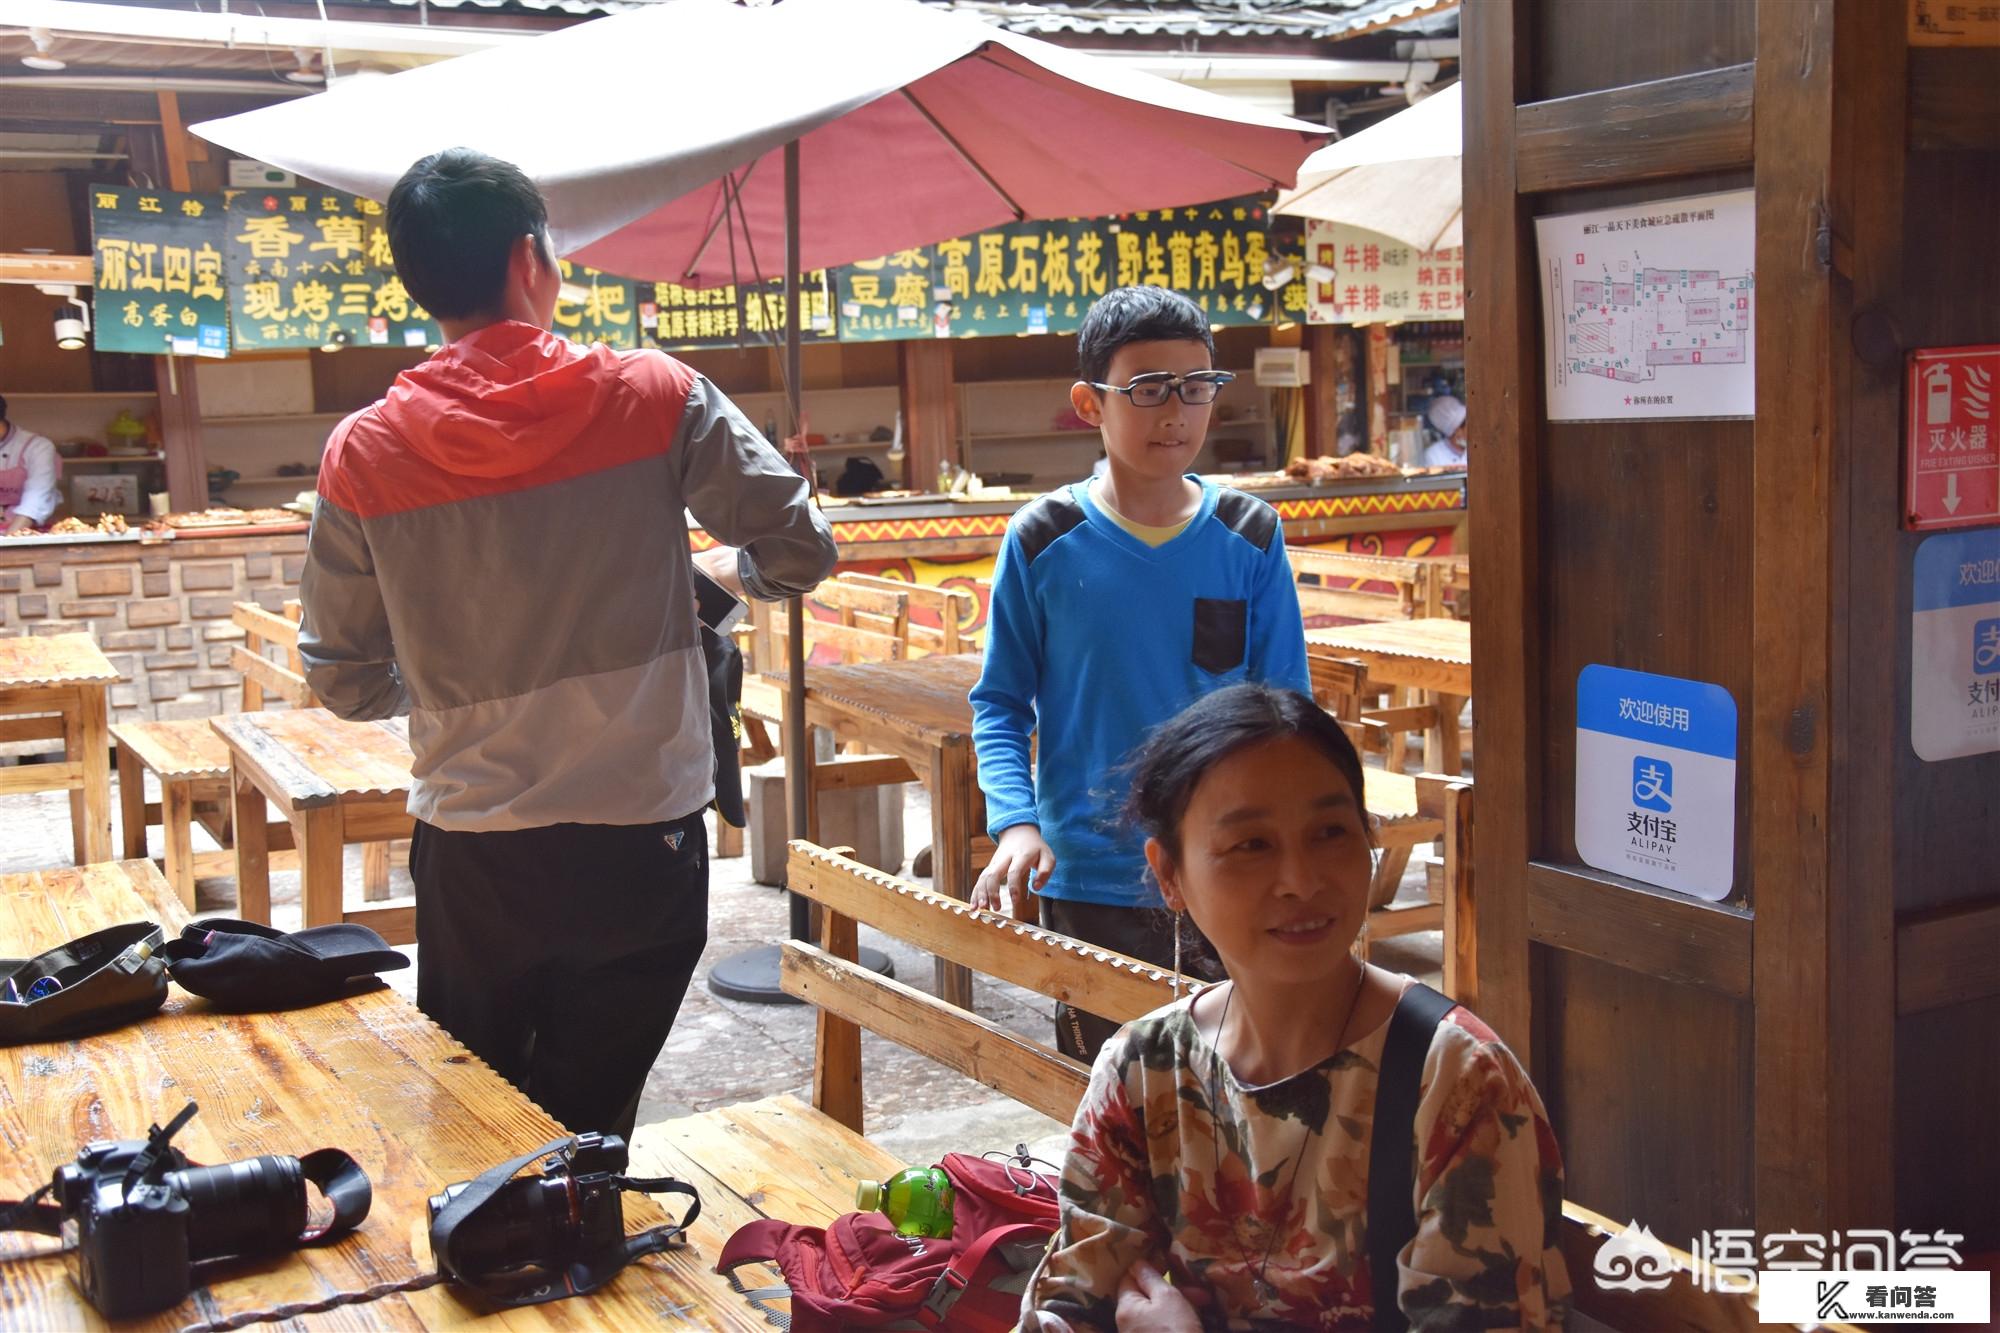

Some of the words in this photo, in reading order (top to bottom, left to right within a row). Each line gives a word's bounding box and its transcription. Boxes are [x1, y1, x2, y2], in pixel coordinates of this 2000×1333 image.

[97, 238, 224, 301] 丽江四宝
[938, 230, 1107, 299] 高原石板花
[849, 273, 928, 309] 豆腐
[1928, 425, 1987, 453] 灭火器
[1959, 559, 2000, 585] 欢迎
[1619, 697, 1690, 732] 欢迎使用
[1627, 811, 1677, 843] 支付宝
[1631, 836, 1672, 855] ALIPAY
